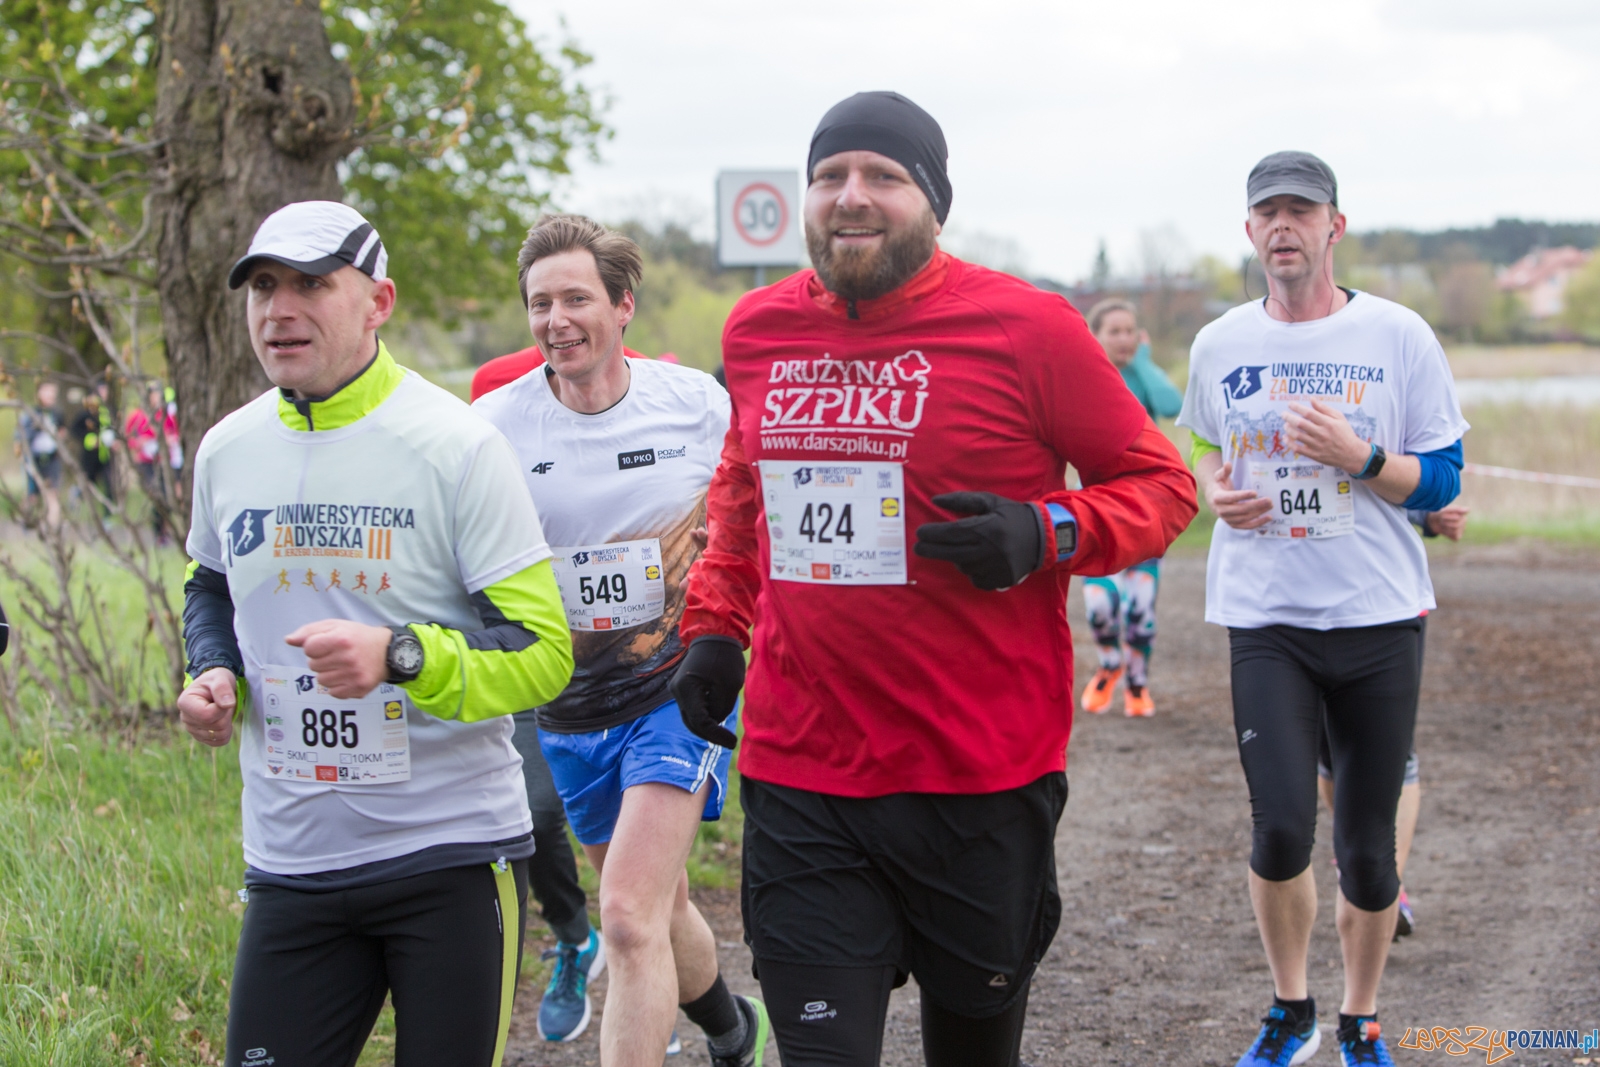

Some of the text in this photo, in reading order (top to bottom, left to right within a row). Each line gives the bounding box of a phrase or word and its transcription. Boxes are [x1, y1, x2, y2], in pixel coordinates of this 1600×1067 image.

[743, 199, 779, 231] 30
[768, 352, 897, 386] DRUŻYNA
[1271, 363, 1384, 383] UNIWERSYTECKA
[1270, 378, 1366, 405] ZADYSZKA IV
[760, 385, 929, 430] SZPIKU
[761, 433, 908, 459] www.darszpiku.pl
[531, 462, 554, 474] 4F
[1280, 488, 1322, 515] 644
[275, 503, 416, 530] UNIWERSYTECKA
[799, 502, 855, 544] 424
[273, 526, 393, 560] ZADYSZKA III
[591, 546, 630, 557] UNIWERSYTECKA
[591, 554, 617, 564] ZADYSZKA
[579, 573, 628, 605] 549
[569, 608, 586, 617] 5KM
[622, 603, 646, 613] 10KM
[302, 707, 359, 749] 885
[287, 750, 307, 761] 5KM
[352, 752, 383, 764] 10KM
